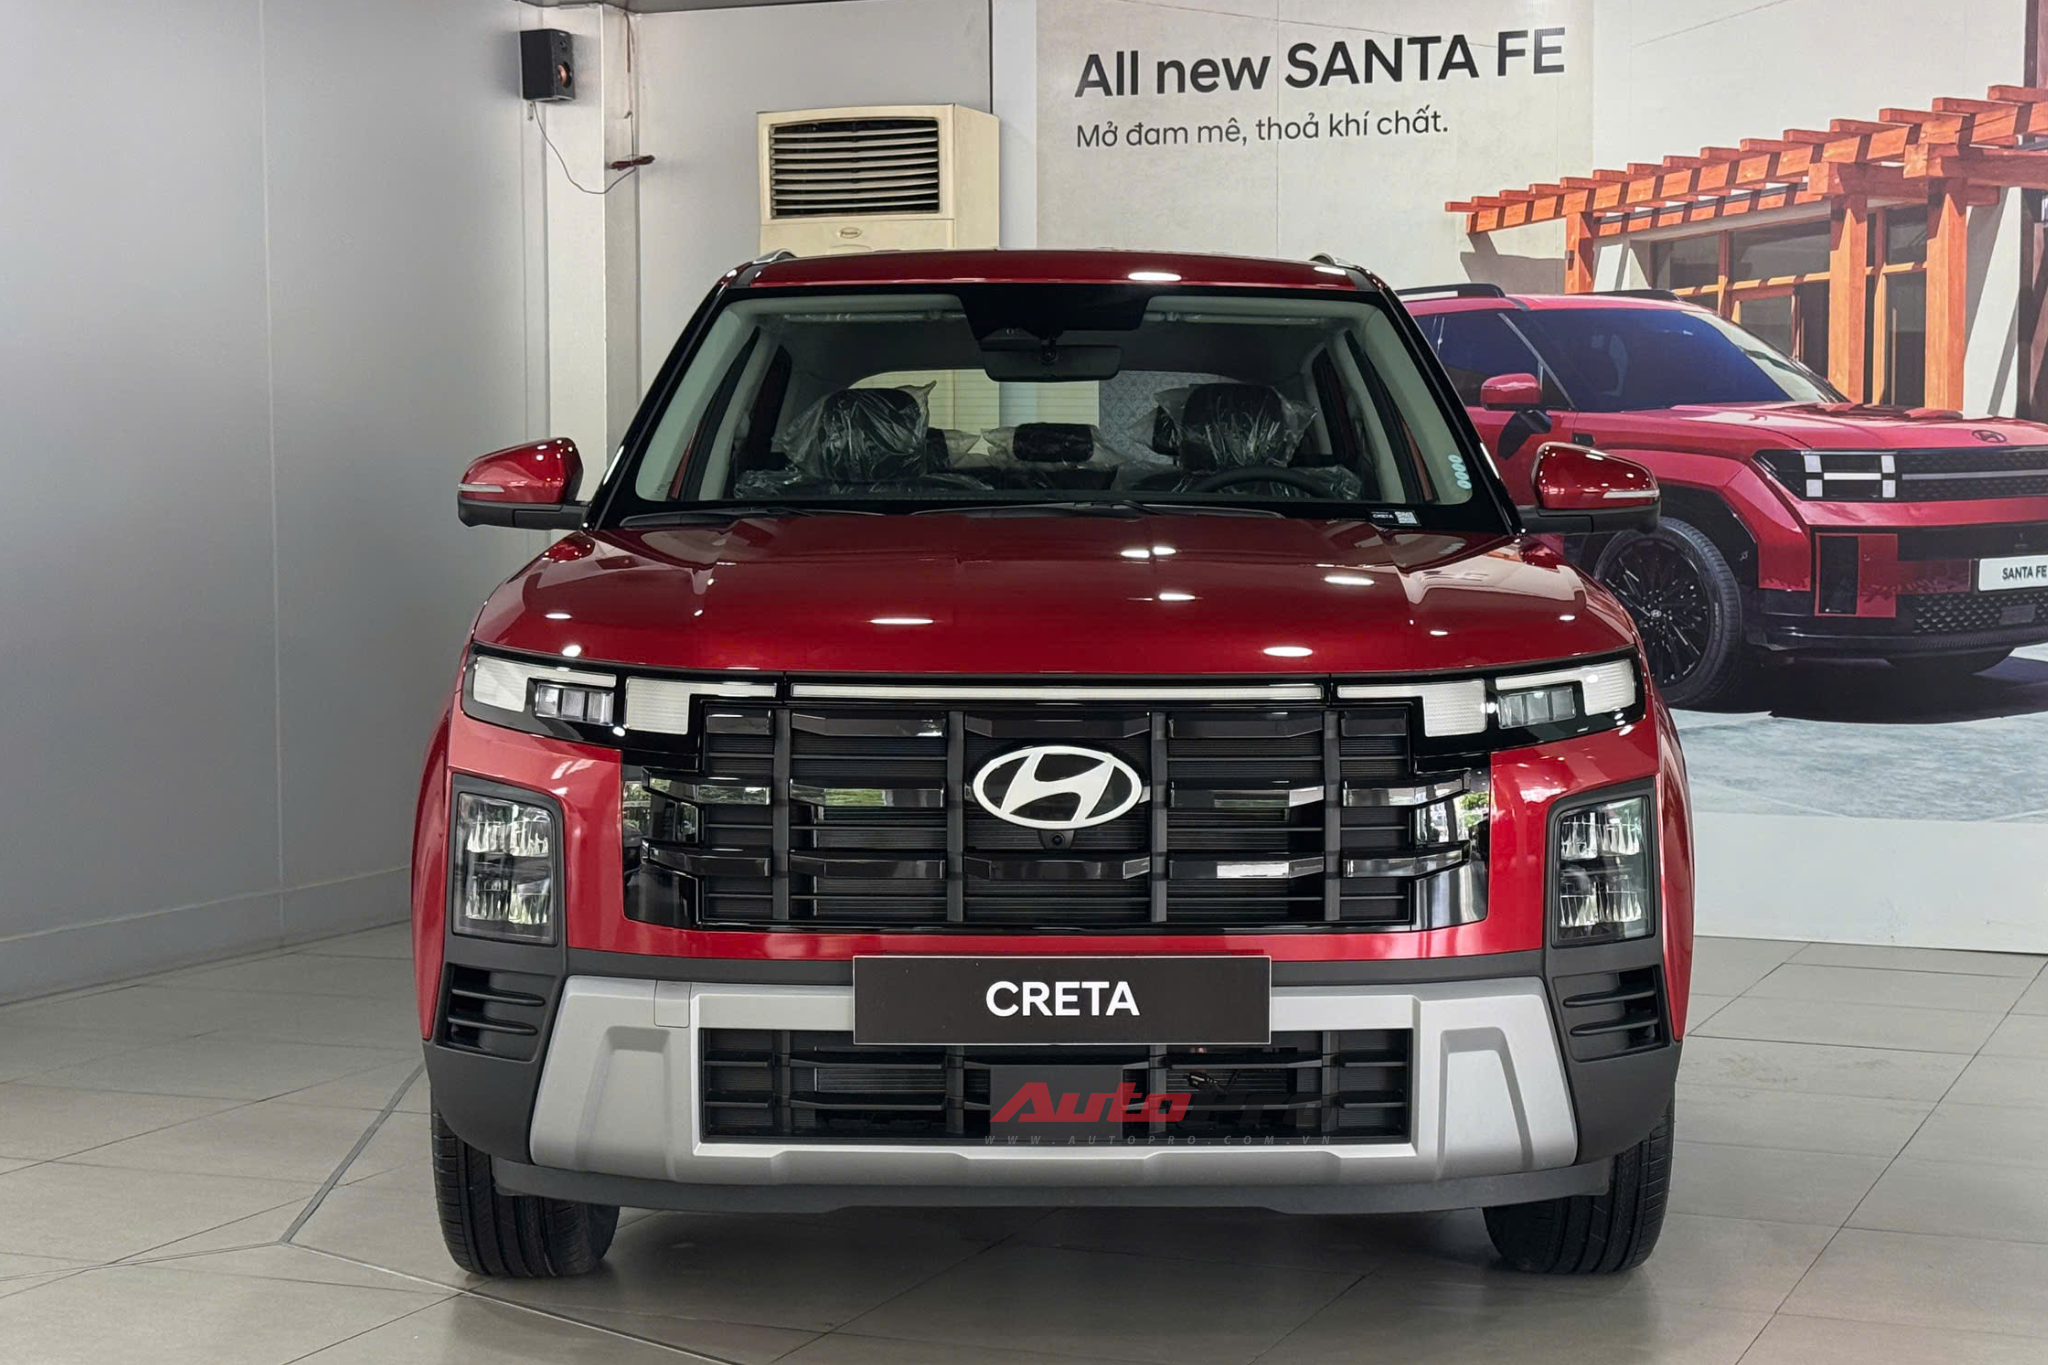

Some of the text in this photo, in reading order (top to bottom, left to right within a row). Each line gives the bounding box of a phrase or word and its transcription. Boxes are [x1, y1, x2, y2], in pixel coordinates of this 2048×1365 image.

[1074, 27, 1565, 98] All new SANTA FE
[1077, 104, 1449, 148] Mở đam mê, thoả khí chất.
[2002, 565, 2048, 580] SANTA FE
[985, 980, 1141, 1017] CRETA
